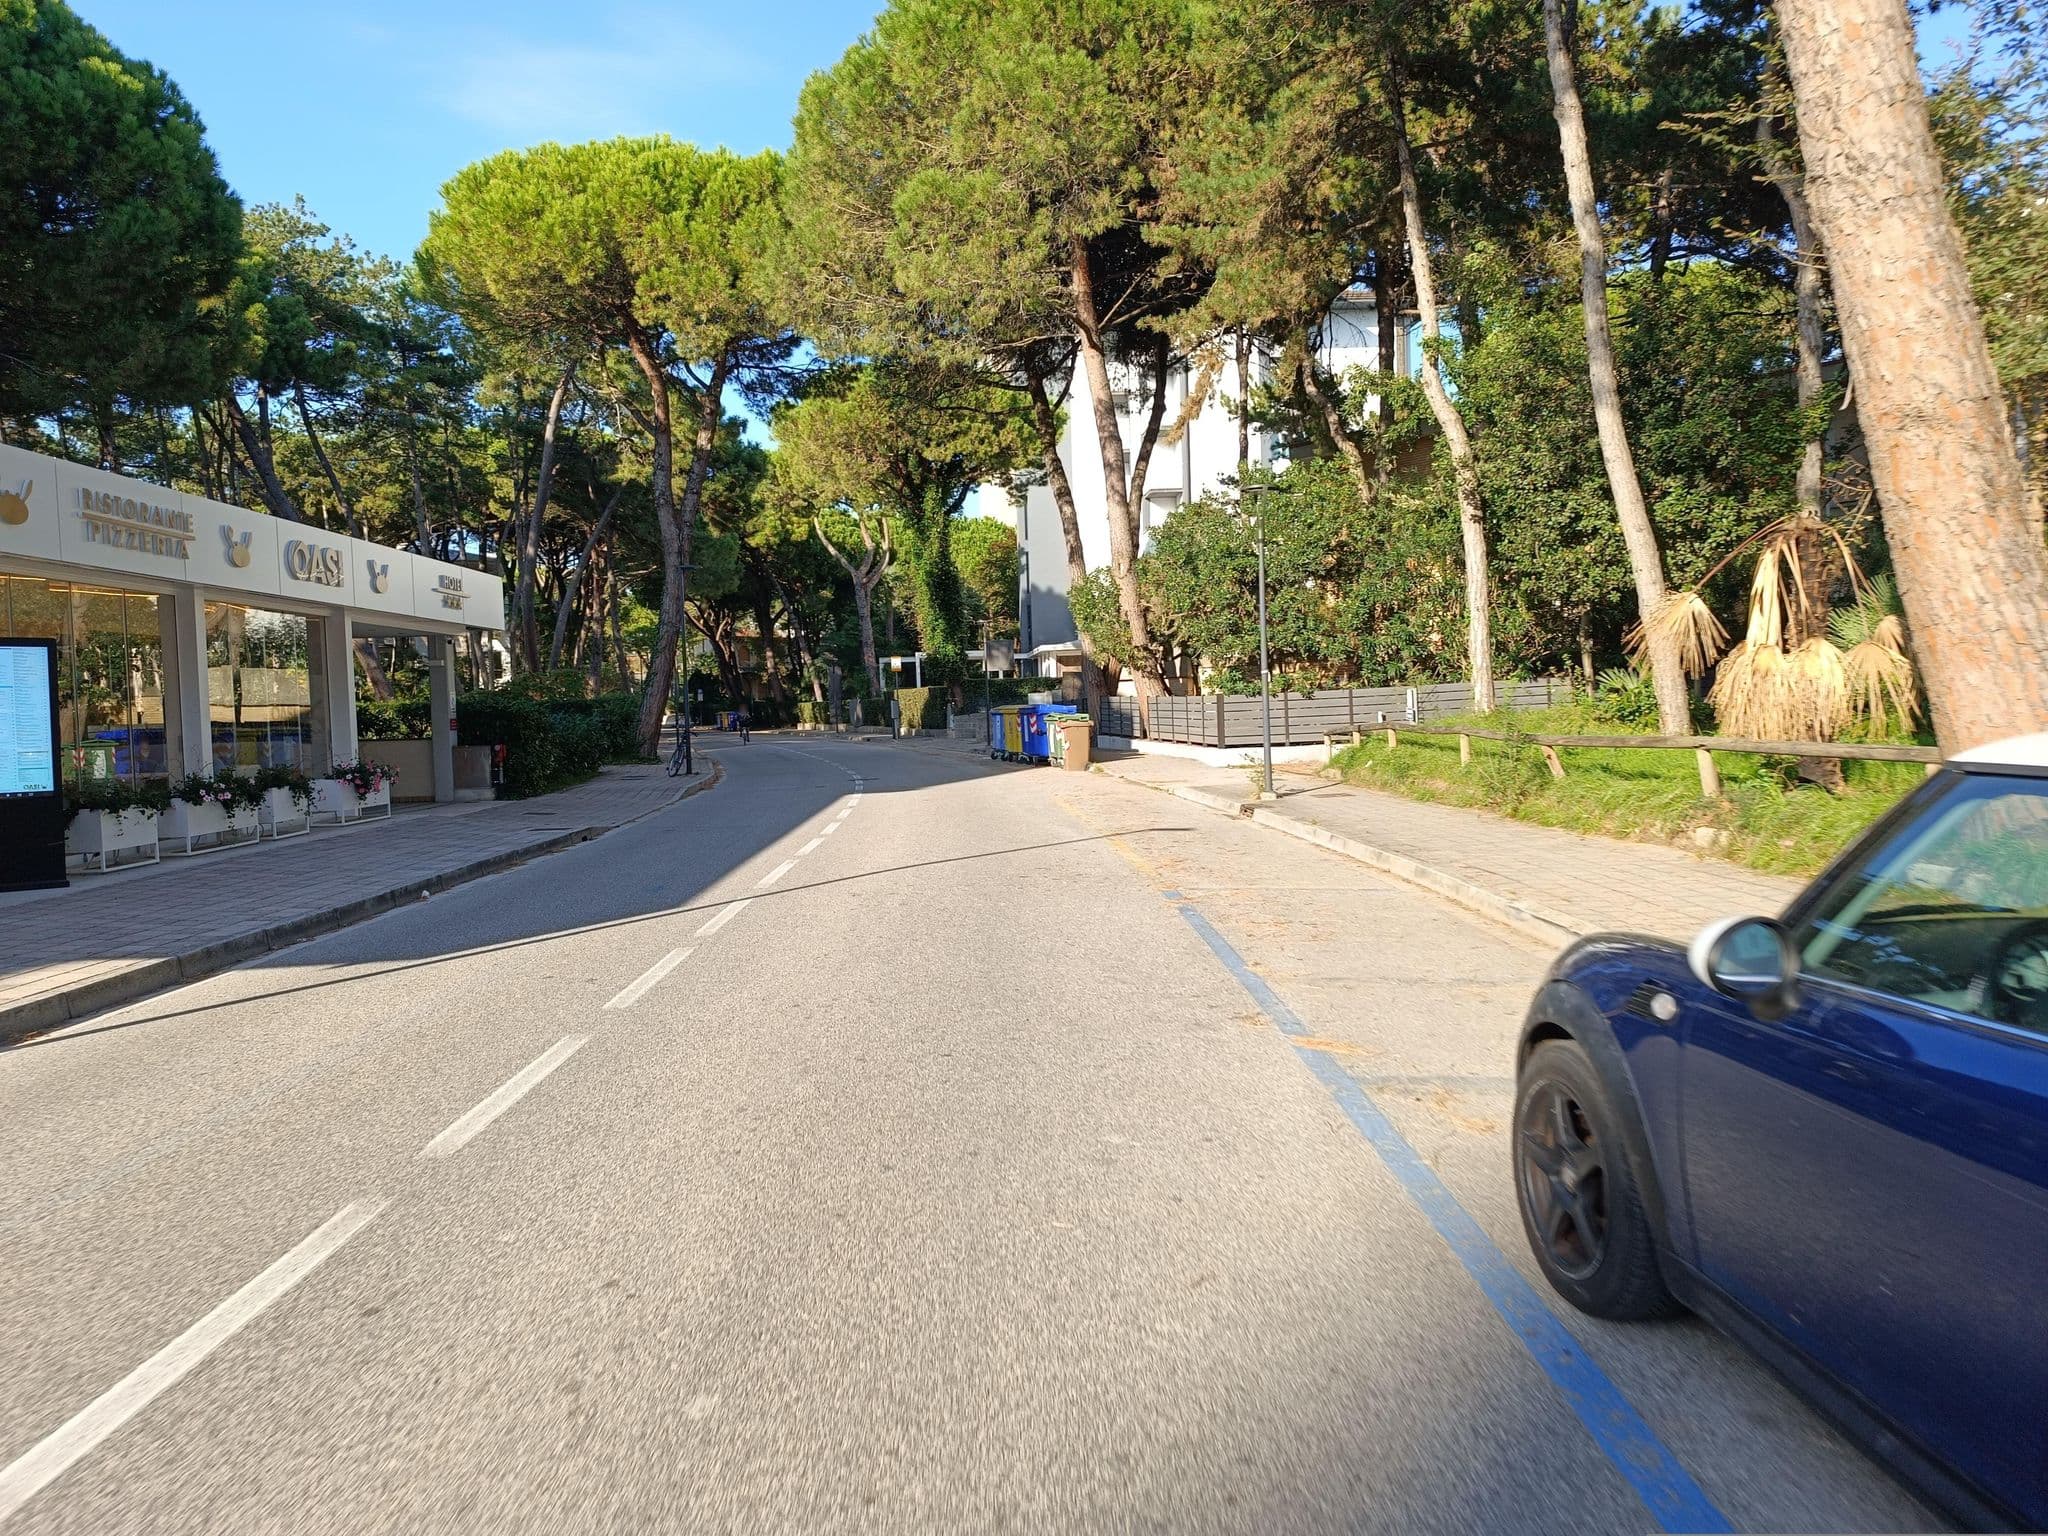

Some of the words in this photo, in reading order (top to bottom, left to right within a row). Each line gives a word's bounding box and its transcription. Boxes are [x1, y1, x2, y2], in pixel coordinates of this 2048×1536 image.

[77, 487, 194, 533] RISTORANTE
[85, 520, 190, 560] PIZZERIA
[283, 539, 345, 588] OASI
[439, 575, 464, 592] HOTEL
